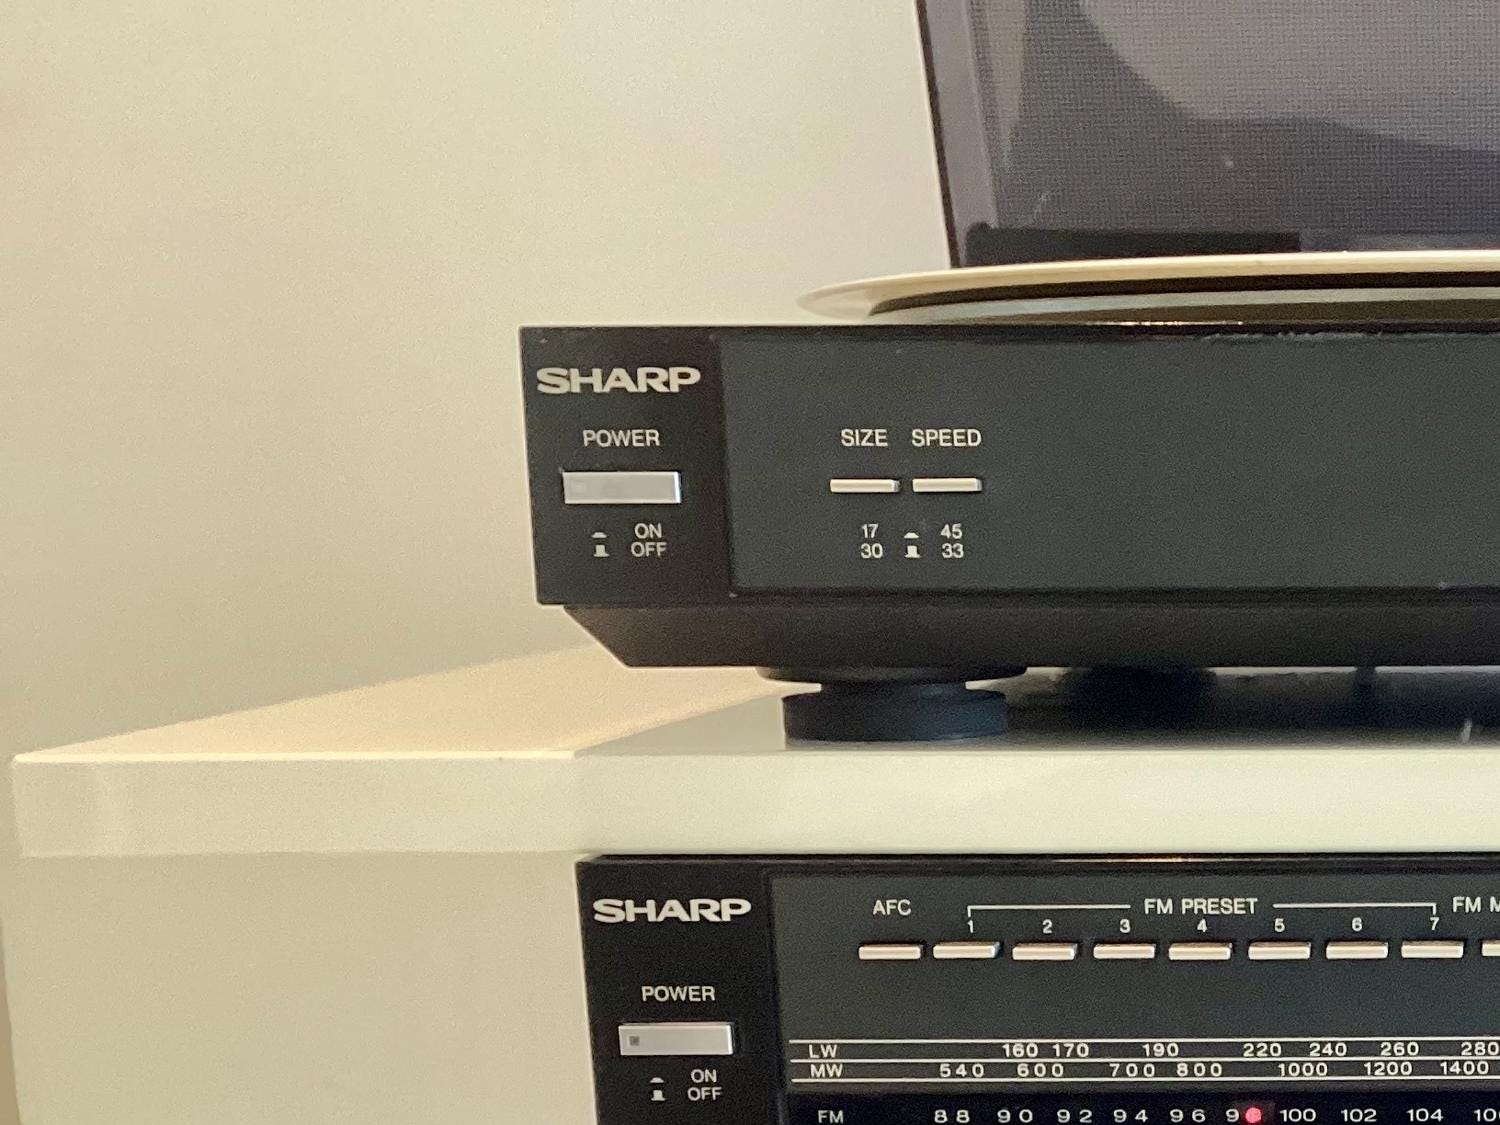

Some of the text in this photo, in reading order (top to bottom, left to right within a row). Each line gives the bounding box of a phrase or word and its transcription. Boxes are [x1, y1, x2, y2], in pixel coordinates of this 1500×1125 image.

[536, 366, 701, 394] SHARP
[582, 429, 661, 448] POWER
[840, 428, 889, 447] SIZE
[911, 428, 982, 448] SPEED
[635, 524, 662, 539] ON
[861, 523, 879, 539] 17
[940, 523, 963, 540] 45
[631, 542, 667, 557] OFF
[860, 542, 884, 559] 30
[941, 542, 965, 559] 33
[592, 898, 752, 923] SHARP
[872, 898, 912, 916] AFC
[1144, 897, 1258, 915] FM PRESET
[1452, 895, 1482, 913] FM
[967, 920, 975, 933] 1
[1042, 918, 1053, 934] 2
[1119, 918, 1131, 934] 3
[1196, 918, 1208, 933] 4
[1274, 917, 1286, 933] 5
[1351, 916, 1363, 932] 6
[1429, 916, 1440, 931] 7
[641, 985, 716, 1002] POWER
[809, 1043, 838, 1059] LW
[1001, 1042, 1039, 1058] 160
[1052, 1042, 1090, 1058] 170
[1142, 1042, 1180, 1057] 190
[1242, 1041, 1282, 1057] 220
[1309, 1041, 1348, 1057] 240
[1379, 1041, 1420, 1057] 260
[1460, 1041, 1500, 1056] 280
[690, 1068, 718, 1084] ON
[809, 1063, 843, 1078] MW
[939, 1062, 985, 1078] 540
[1016, 1062, 1065, 1078] 600
[1109, 1062, 1156, 1078] 700
[1176, 1062, 1223, 1078] 800
[1278, 1061, 1329, 1077] 1000
[1363, 1061, 1413, 1077] 1200
[1439, 1060, 1490, 1076] 1400
[687, 1086, 721, 1101] OFF
[817, 1109, 844, 1124] FM
[933, 1109, 971, 1124] 88
[996, 1108, 1034, 1124] 90
[1056, 1108, 1093, 1124] 92
[1112, 1108, 1148, 1123] 94
[1169, 1108, 1206, 1123] 96
[1280, 1107, 1317, 1123] 100
[1341, 1107, 1377, 1123] 102
[1407, 1107, 1444, 1123] 104
